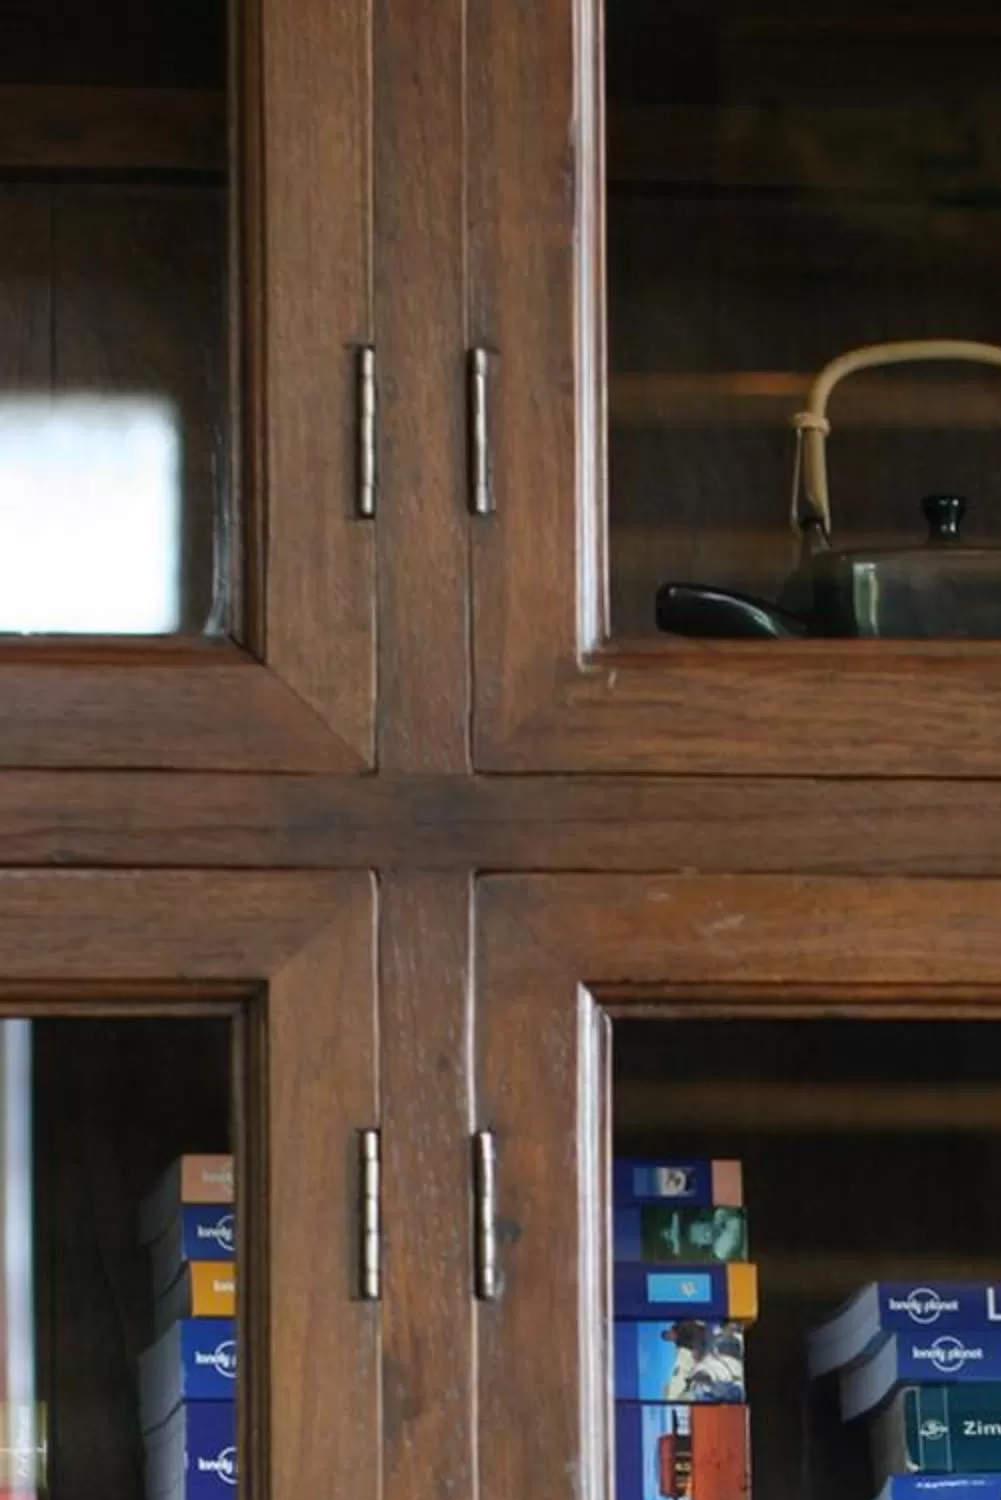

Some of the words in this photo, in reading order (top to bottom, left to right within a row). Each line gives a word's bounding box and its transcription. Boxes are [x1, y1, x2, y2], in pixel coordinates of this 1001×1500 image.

[889, 1298, 922, 1314] lonely
[923, 1299, 959, 1312] planet
[912, 1346, 945, 1362] lonely
[946, 1347, 983, 1360] planet
